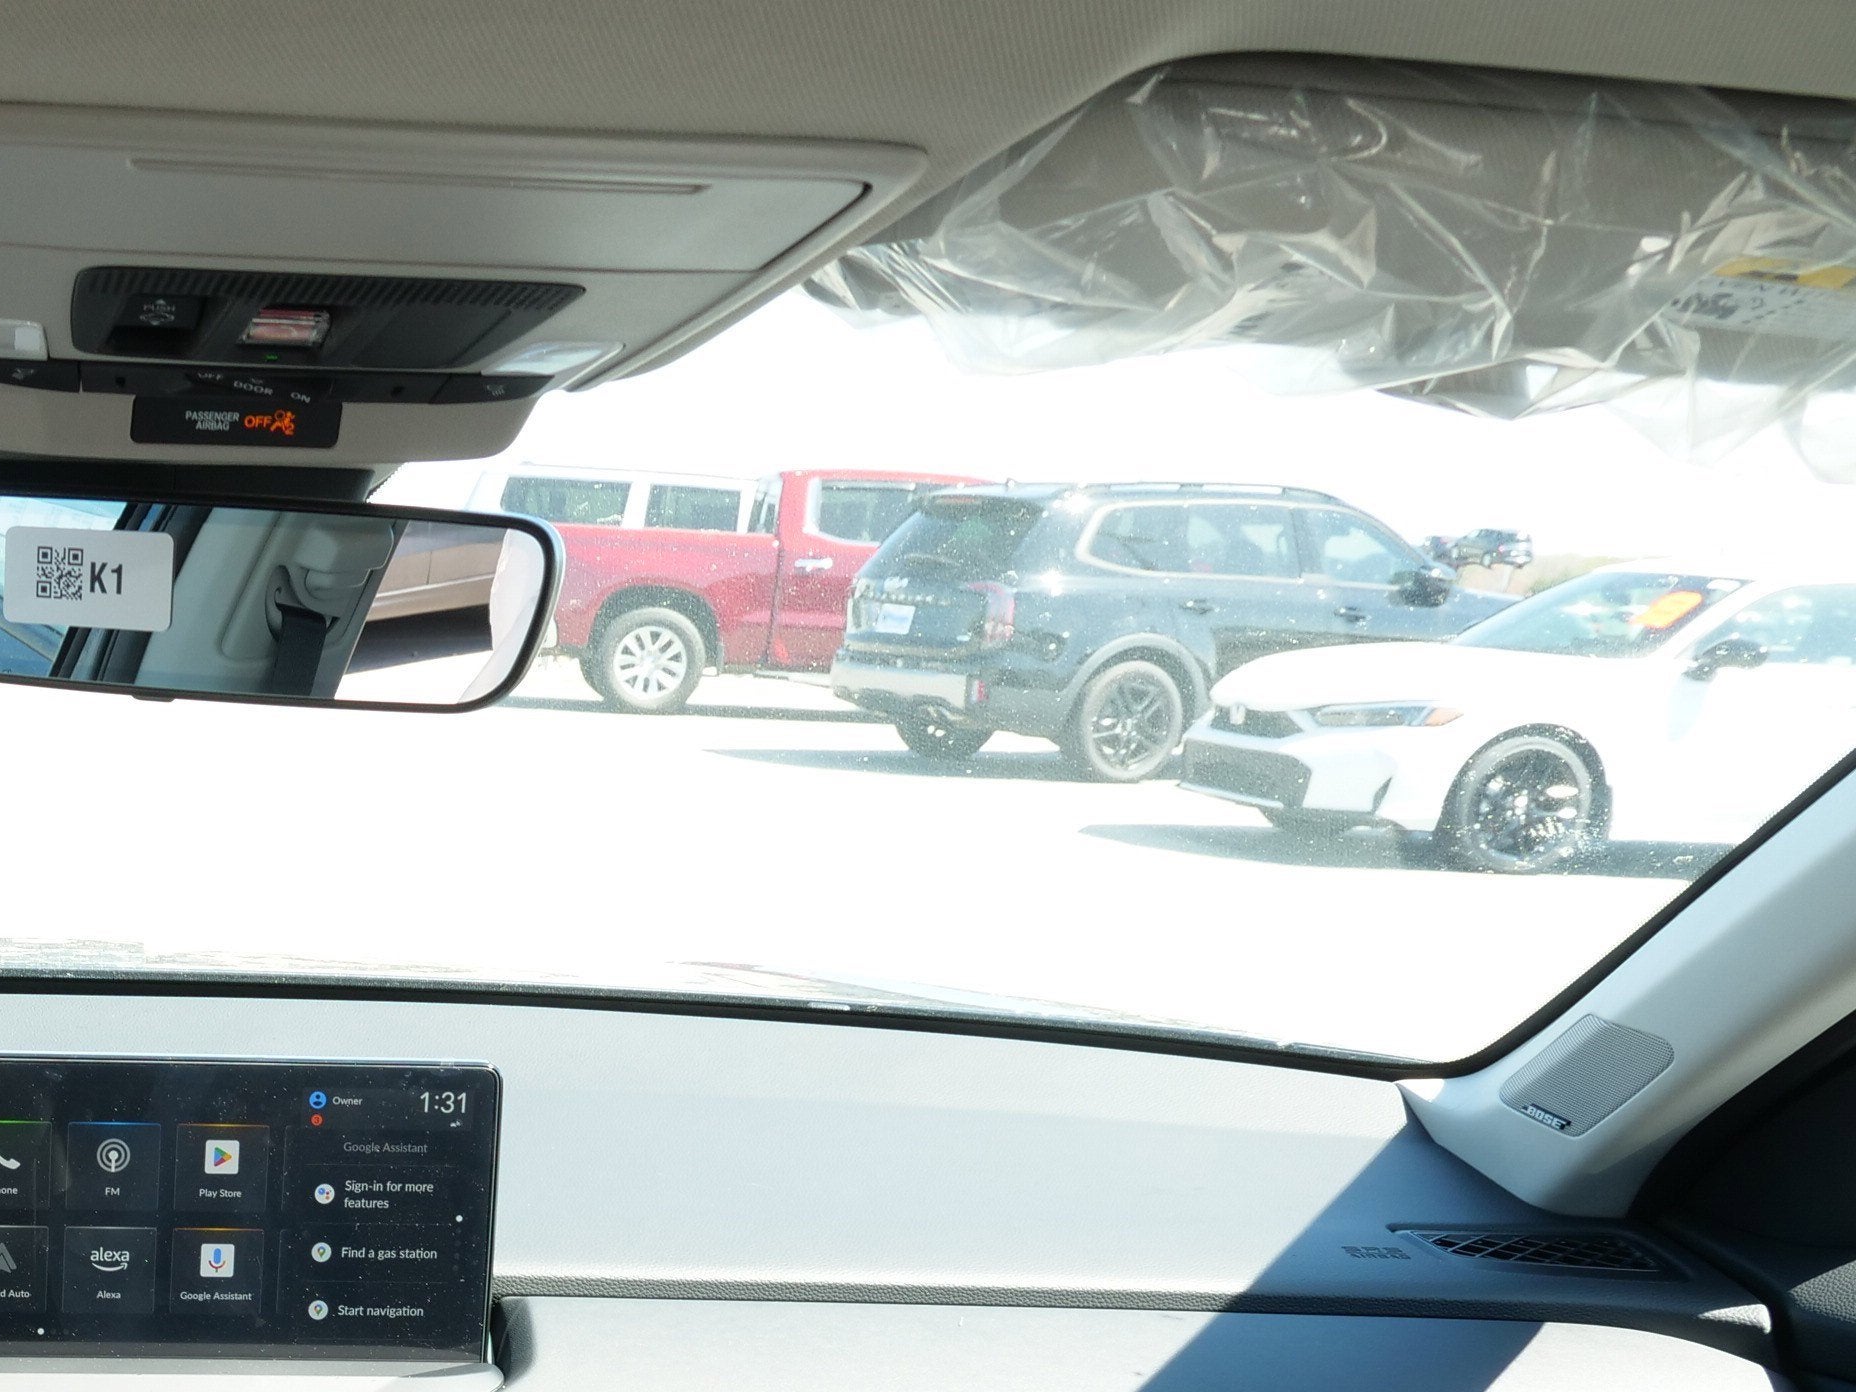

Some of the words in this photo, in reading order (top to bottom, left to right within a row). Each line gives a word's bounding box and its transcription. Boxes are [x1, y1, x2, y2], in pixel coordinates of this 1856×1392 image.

[233, 381, 273, 396] DOOR
[290, 392, 311, 403] ON
[185, 411, 239, 421] PASSENGER
[244, 415, 271, 428] OFF
[196, 421, 229, 431] AIRBAG
[90, 562, 124, 595] K1
[332, 1097, 362, 1106] Owner
[420, 1092, 467, 1113] 1:31
[344, 1142, 380, 1154] Google
[383, 1142, 427, 1153] Assistant
[105, 1187, 119, 1196] FM
[345, 1180, 382, 1194] Sign-in
[385, 1180, 400, 1192] for
[403, 1182, 433, 1192] more
[199, 1189, 217, 1199] Play
[219, 1188, 241, 1198] Store
[344, 1197, 389, 1209] features
[91, 1247, 129, 1262] alexa
[341, 1247, 362, 1259] Find
[366, 1251, 372, 1259] a
[376, 1251, 395, 1261] gas
[399, 1247, 437, 1259] station
[12, 1289, 30, 1298] Auto
[97, 1290, 121, 1300] Alexa
[180, 1291, 210, 1302] Google
[213, 1291, 251, 1301] Assistant
[338, 1305, 362, 1317] Start
[365, 1305, 423, 1318] navigation
